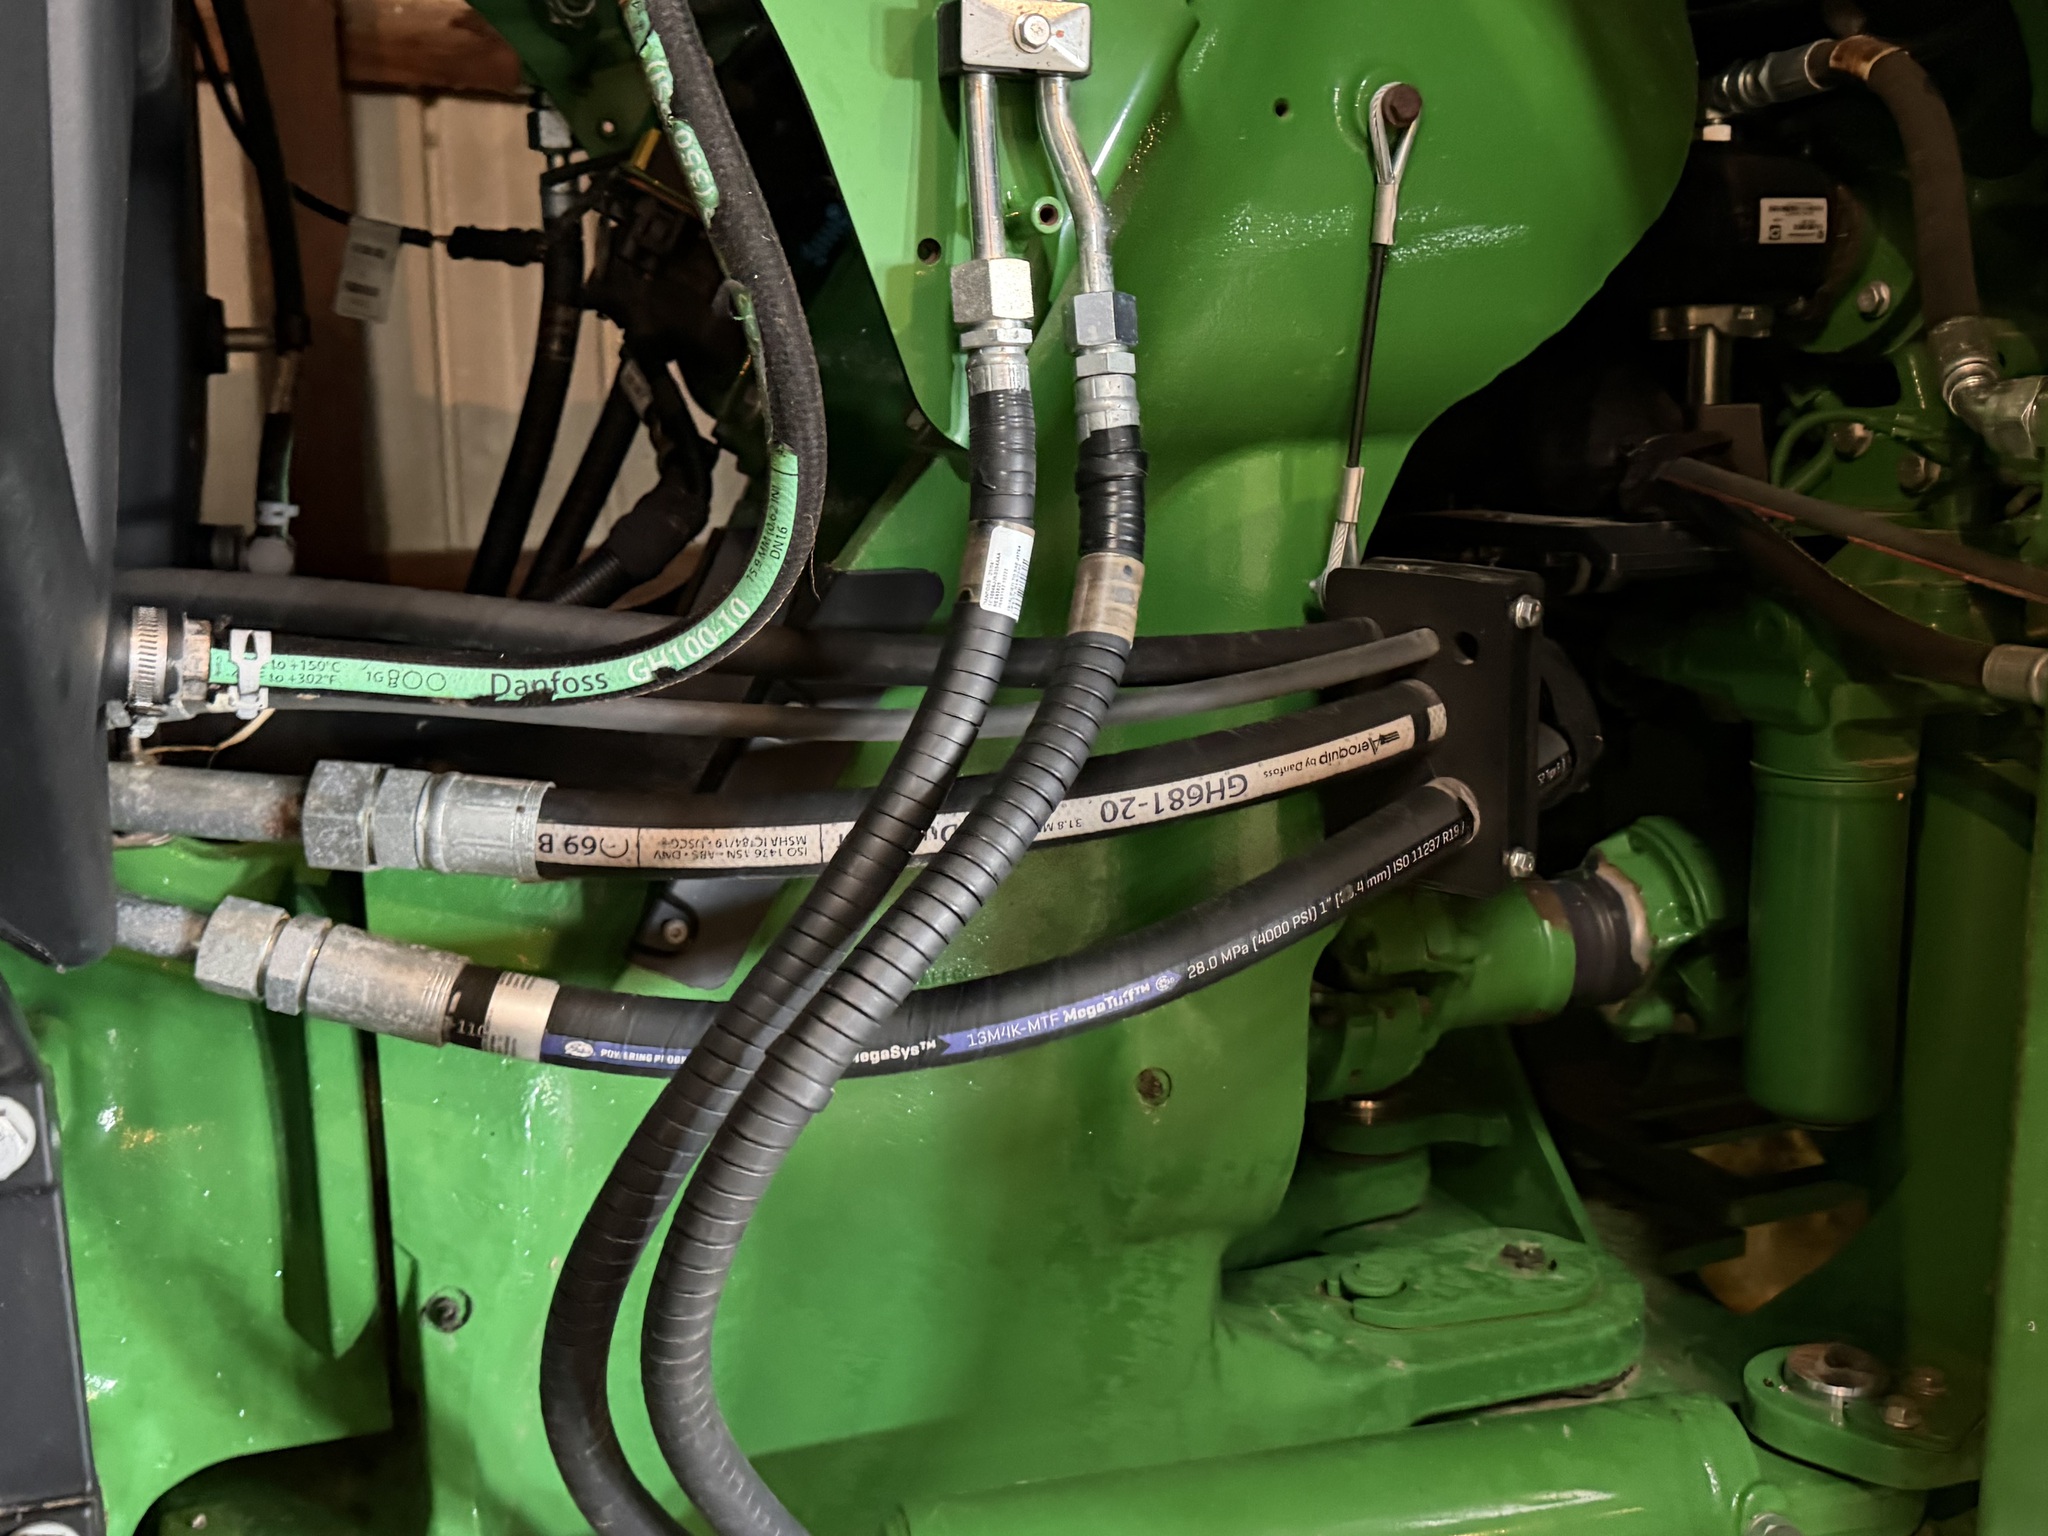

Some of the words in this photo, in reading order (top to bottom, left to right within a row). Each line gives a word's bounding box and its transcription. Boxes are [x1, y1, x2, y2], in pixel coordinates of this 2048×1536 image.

[770, 526, 788, 560] DN16
[1319, 735, 1381, 766] Aeroquip
[1263, 761, 1303, 778] Danfoss
[1305, 757, 1317, 767] by
[1100, 773, 1248, 823] GH681-20
[1055, 818, 1082, 830] 31.8
[538, 833, 554, 854] B
[563, 835, 598, 856] 69
[771, 835, 808, 848] MSHA
[654, 849, 681, 860] DNV
[755, 848, 783, 860] 1436
[787, 847, 808, 858] ISO
[1187, 956, 1218, 979] 28.0
[1221, 944, 1249, 965] MPa
[1293, 905, 1318, 929] PSI)
[1366, 865, 1392, 890] mm)
[1393, 855, 1410, 874] ISO
[1412, 837, 1441, 864] 11237
[1442, 825, 1460, 844] R19
